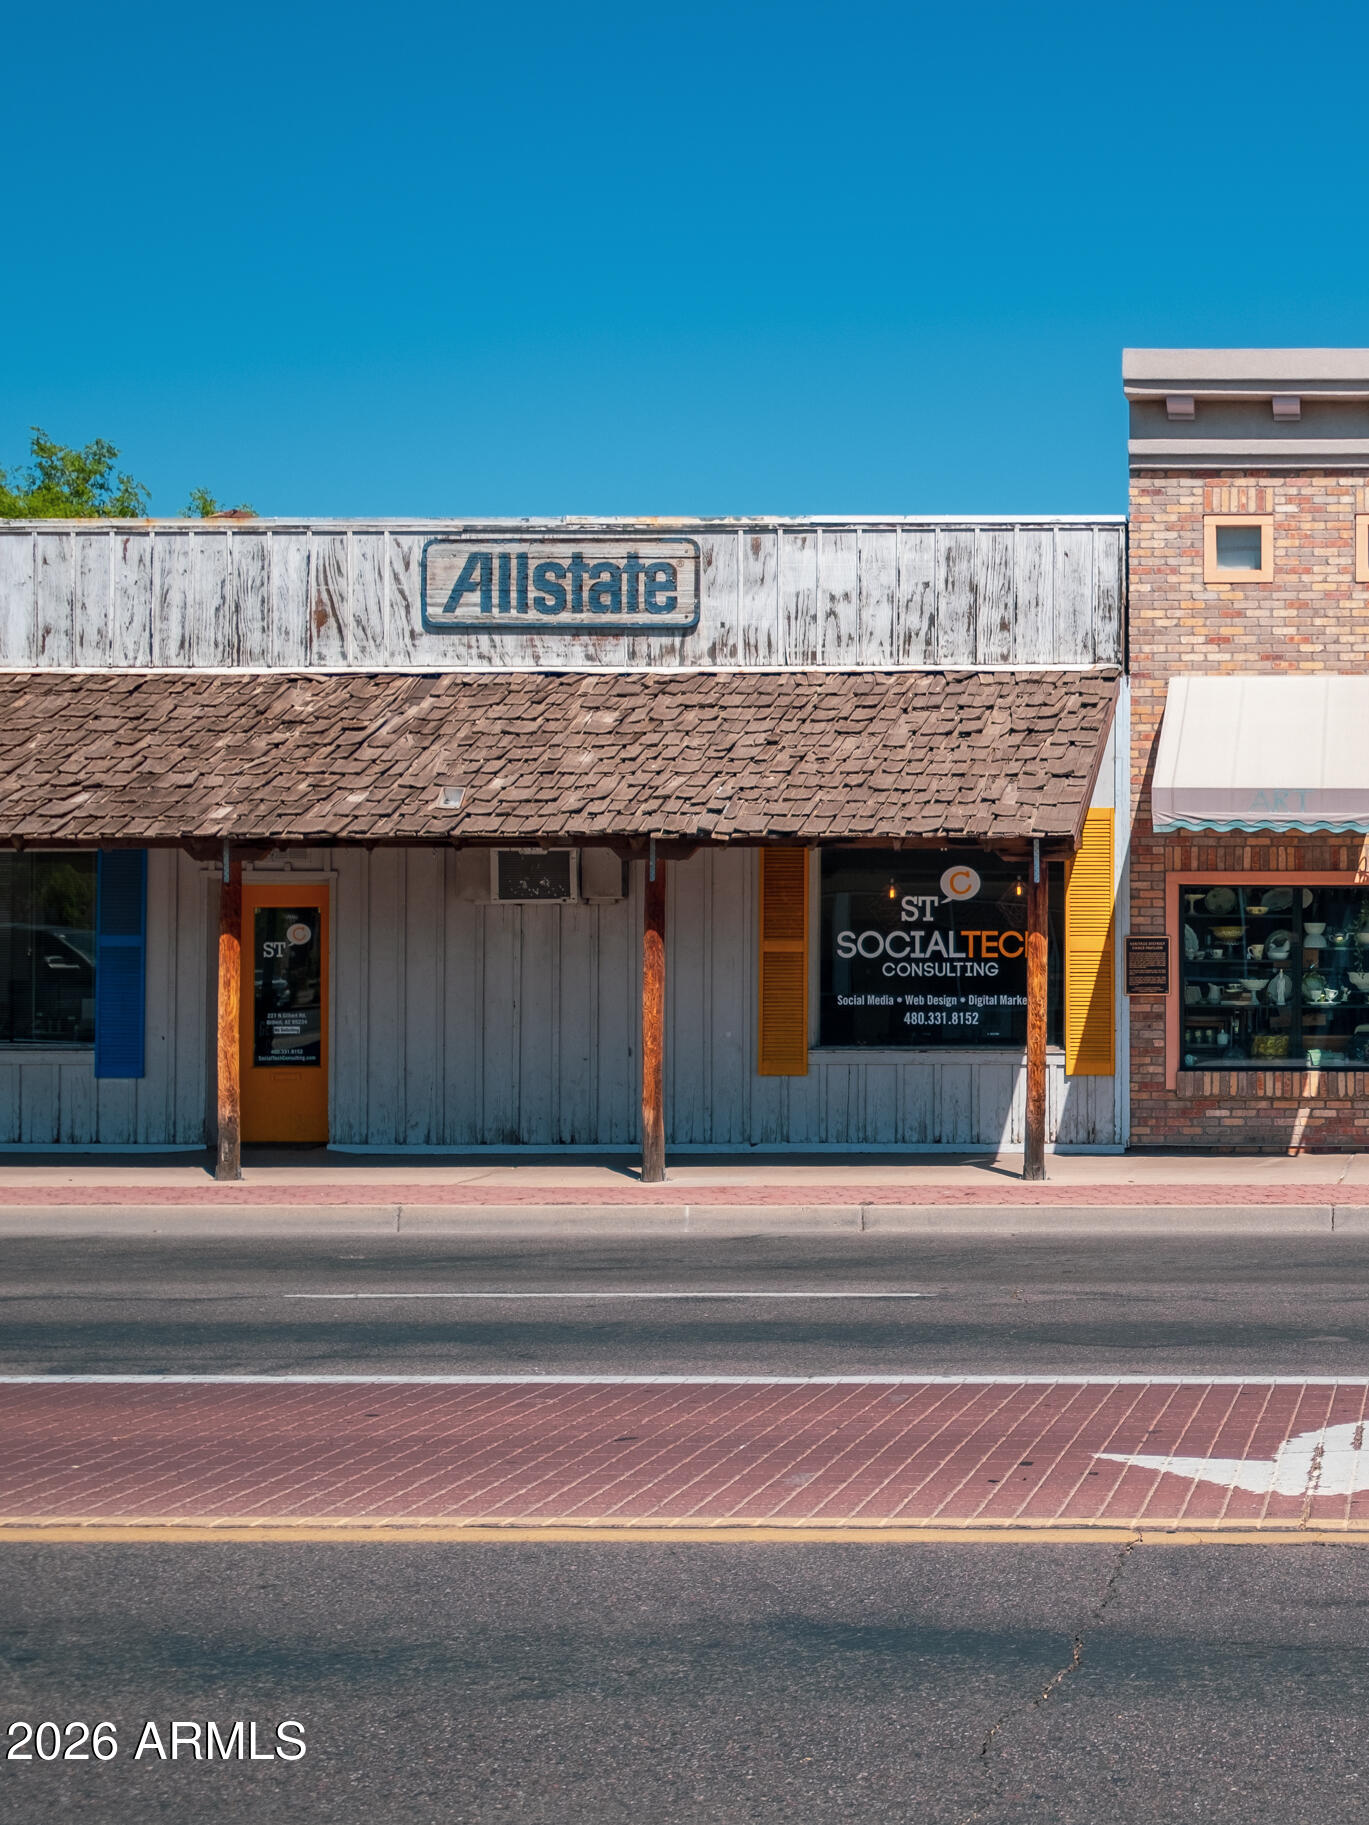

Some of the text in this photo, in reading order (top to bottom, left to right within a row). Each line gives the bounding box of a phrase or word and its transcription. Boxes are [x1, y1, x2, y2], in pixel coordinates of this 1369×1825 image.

[442, 551, 678, 615] Allstate
[1247, 789, 1317, 813] ART
[882, 962, 999, 977] CONSULTING
[837, 995, 865, 1006] Social
[867, 995, 894, 1006] Media
[905, 995, 925, 1006] Web
[927, 995, 957, 1007] Design
[968, 995, 998, 1007] Digital
[904, 1012, 979, 1025] 480.331.8152
